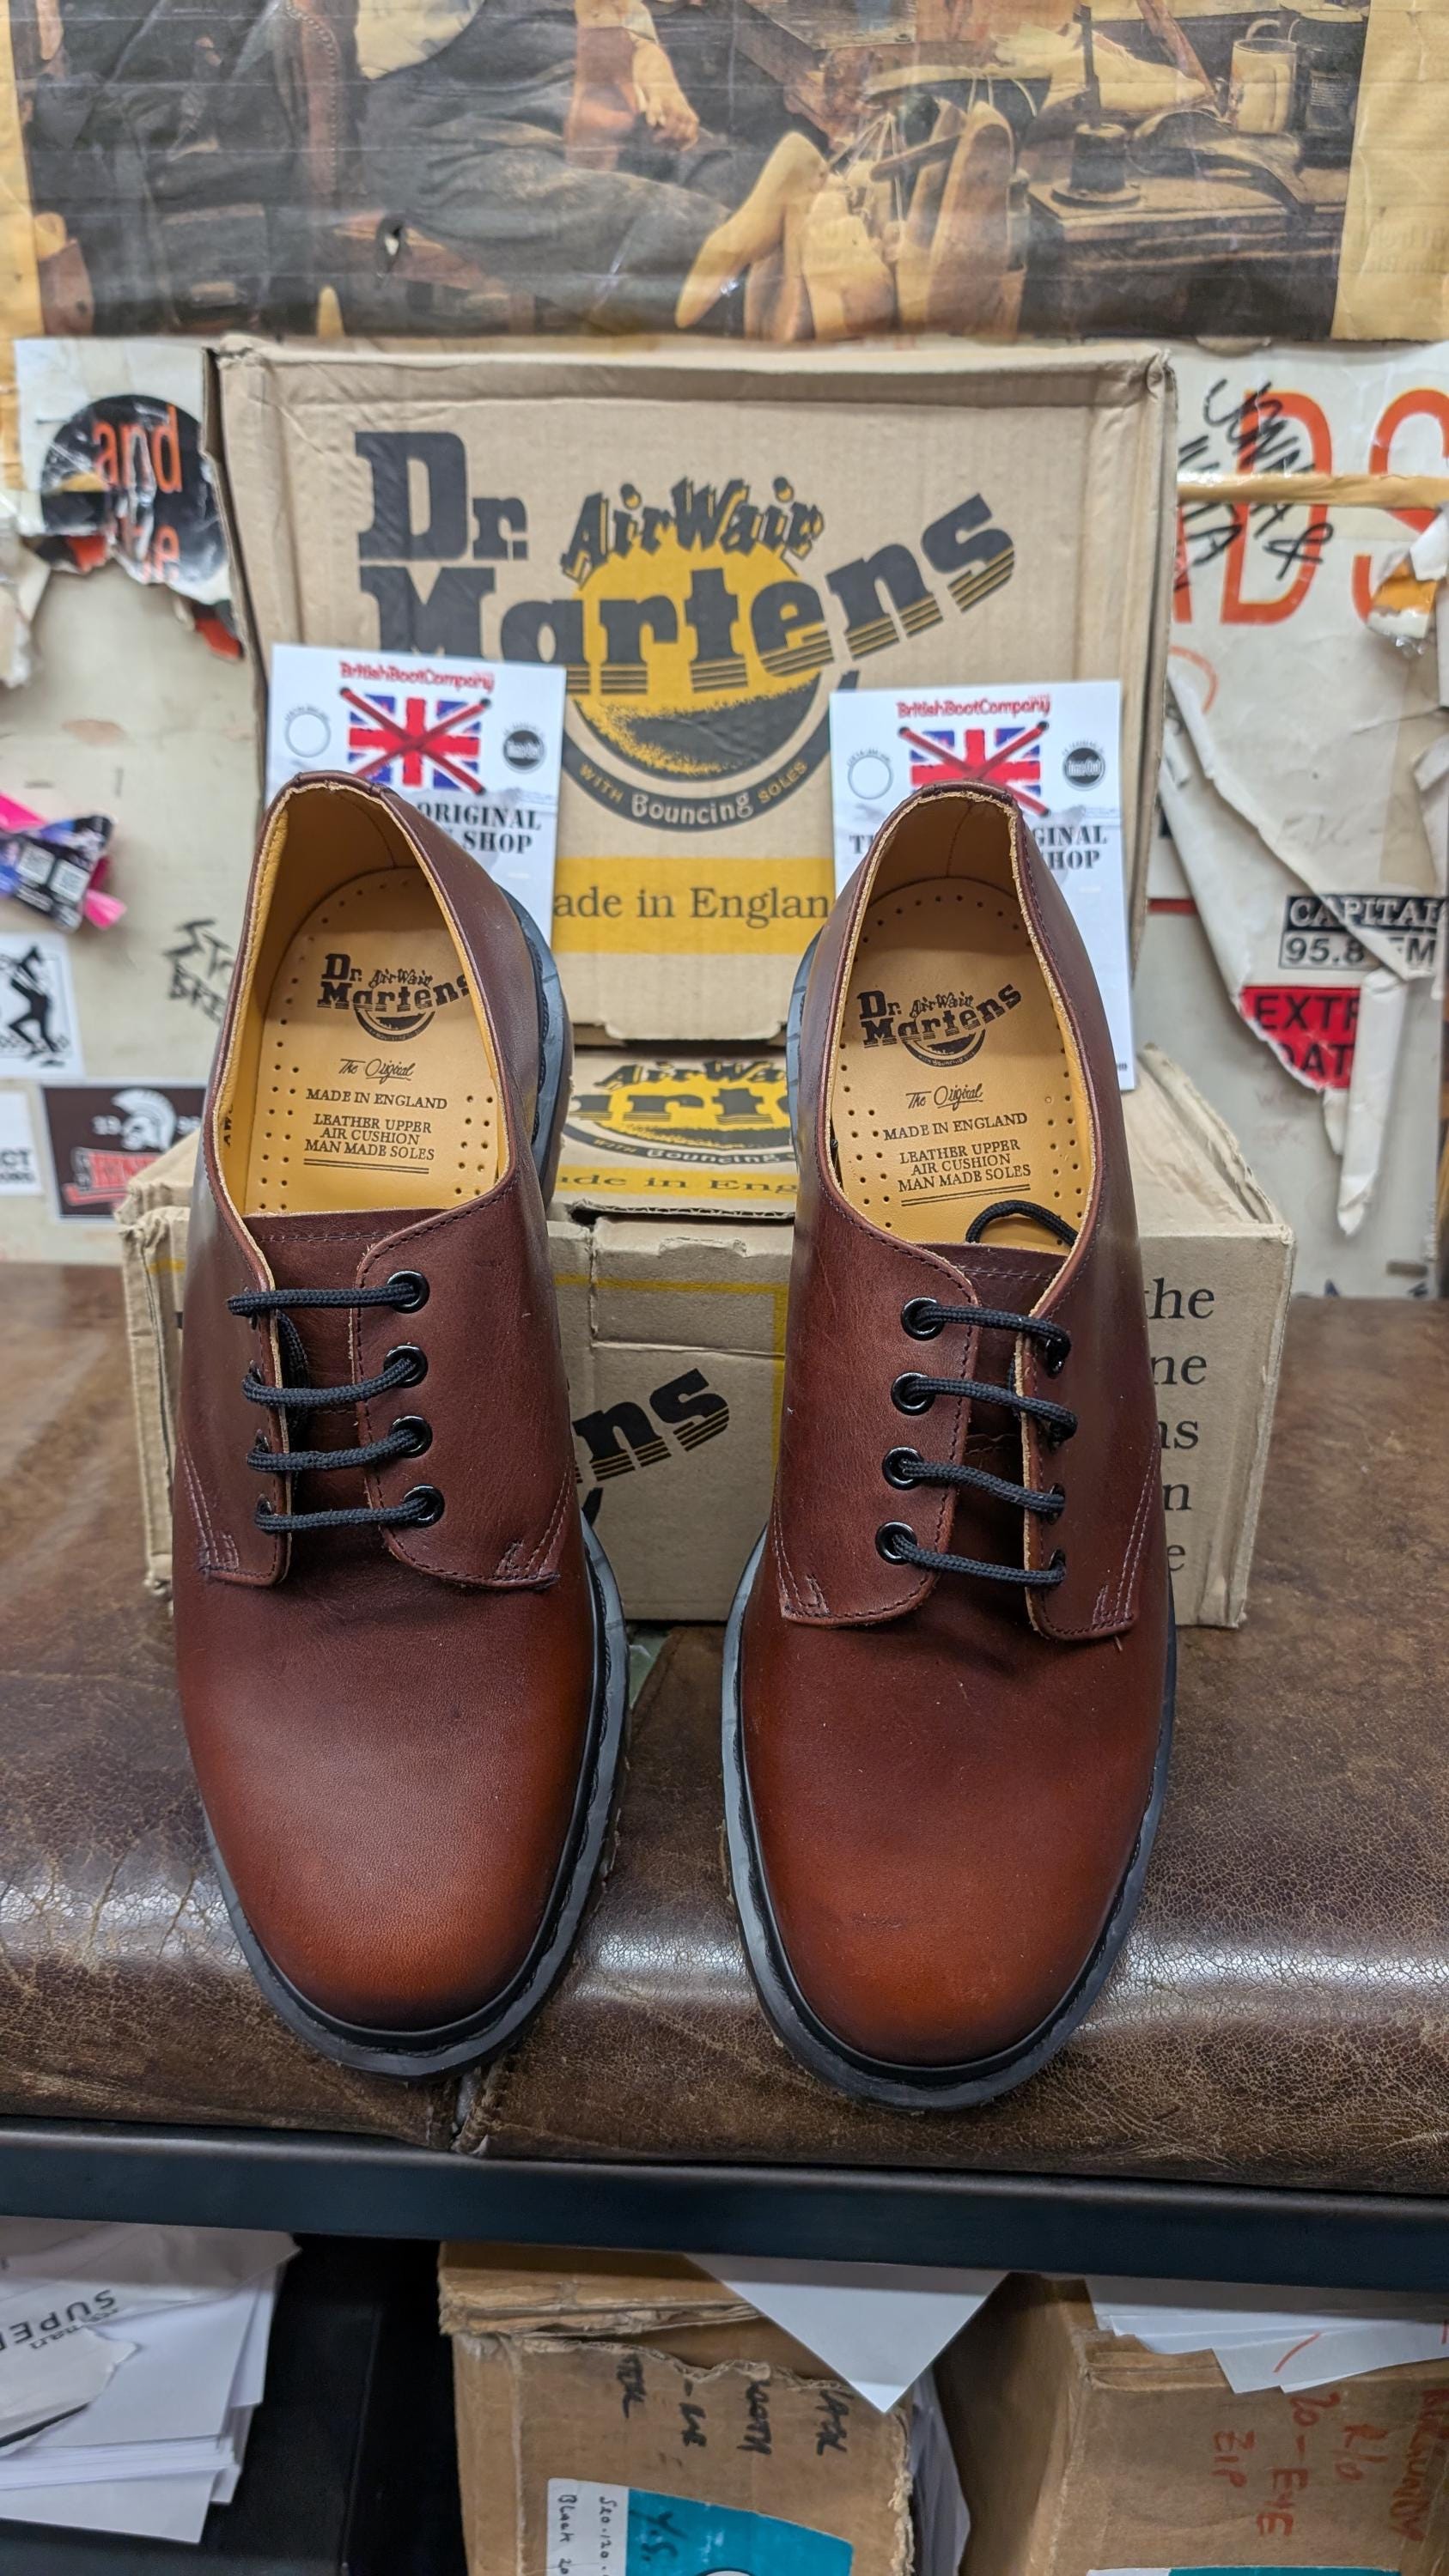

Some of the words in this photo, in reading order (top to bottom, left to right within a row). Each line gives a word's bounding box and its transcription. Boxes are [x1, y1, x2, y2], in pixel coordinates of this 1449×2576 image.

[561, 476, 825, 587] AirWair
[358, 493, 1016, 695] Martens
[580, 762, 624, 804] WITH
[631, 791, 754, 825] Bouncing
[757, 759, 808, 805] SOLES
[463, 829, 533, 854] SHOP
[1046, 849, 1100, 870] HOP
[637, 890, 676, 919] in
[1288, 936, 1365, 963] 95.8
[861, 983, 1022, 1048] Martens
[338, 1058, 366, 1075] The
[306, 1089, 351, 1103] MADE
[354, 1092, 371, 1103] IN
[374, 1094, 447, 1109] ENGLAND
[905, 1091, 932, 1109] The
[314, 1114, 381, 1129] LEATHER
[386, 1119, 431, 1133] UPPER
[884, 1125, 928, 1141] MADE
[932, 1122, 949, 1134] IN
[953, 1112, 1028, 1133] ENGLAND
[320, 1128, 348, 1139] AIR
[351, 1130, 419, 1145] CUSHION
[304, 1139, 341, 1153] MAN
[344, 1142, 387, 1157] MADE
[390, 1146, 435, 1160] SOLES
[647, 1143, 781, 1165] Bouncing
[900, 1147, 965, 1164] LEATHER
[971, 1139, 1020, 1156] UPPER
[910, 1163, 937, 1176] AIR
[941, 1153, 1010, 1172] CUSHION
[645, 1177, 687, 1189] in
[898, 1178, 936, 1193] MAN
[939, 1171, 982, 1188] MADE
[985, 1164, 1031, 1181] SOLES
[1143, 1277, 1215, 1320] he
